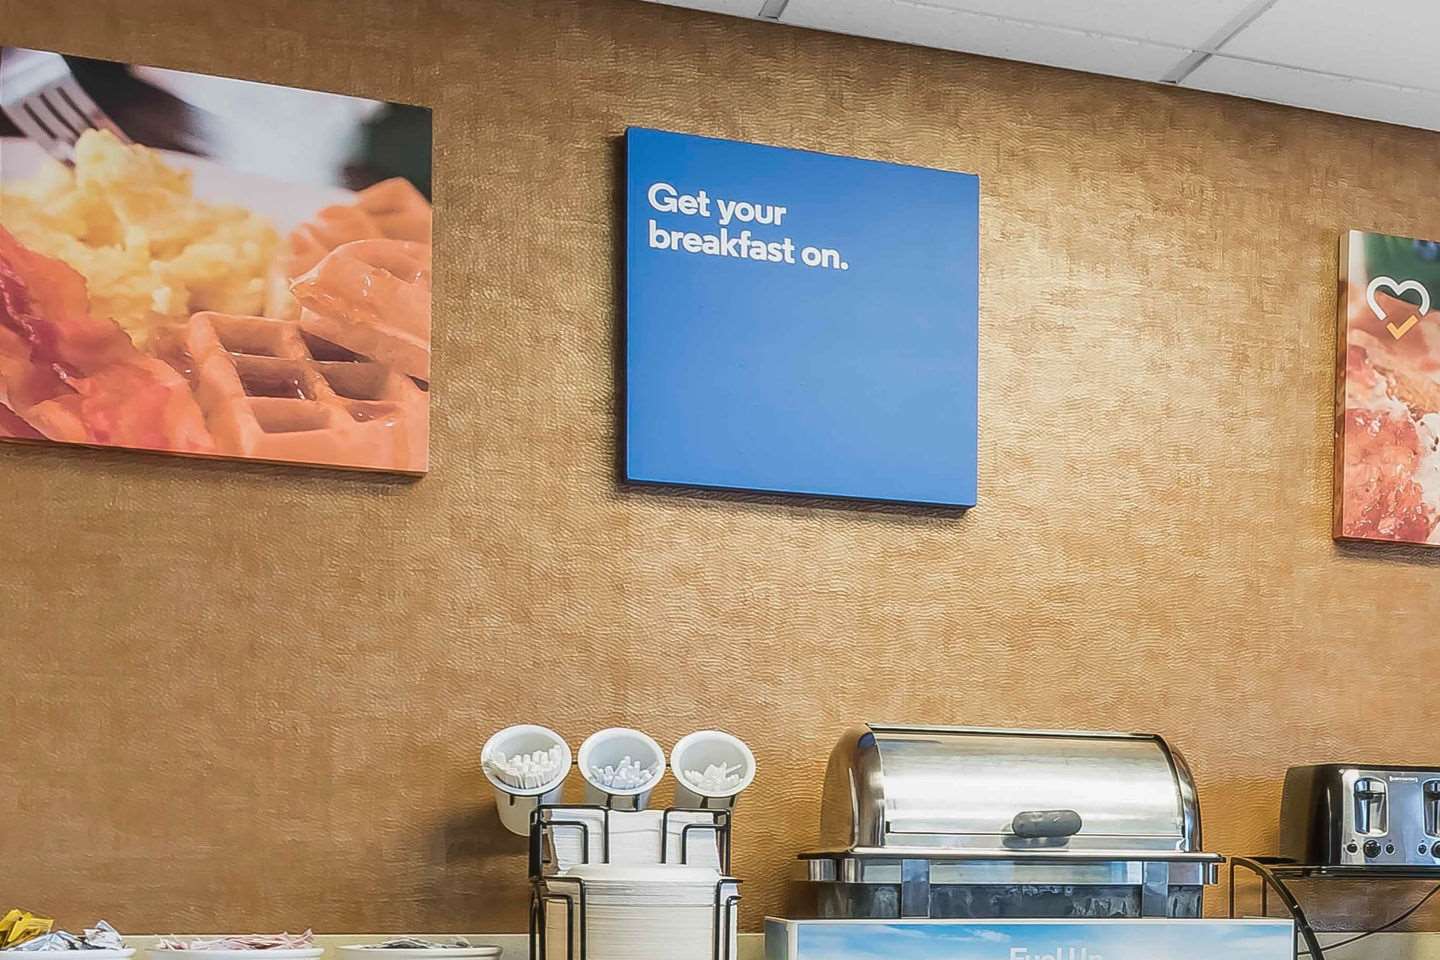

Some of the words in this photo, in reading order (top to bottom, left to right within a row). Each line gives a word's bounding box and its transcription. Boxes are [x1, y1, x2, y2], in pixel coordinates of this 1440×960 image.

[648, 182, 711, 217] Get
[718, 198, 787, 226] your
[649, 220, 796, 265] breakfast
[801, 244, 849, 271] on.
